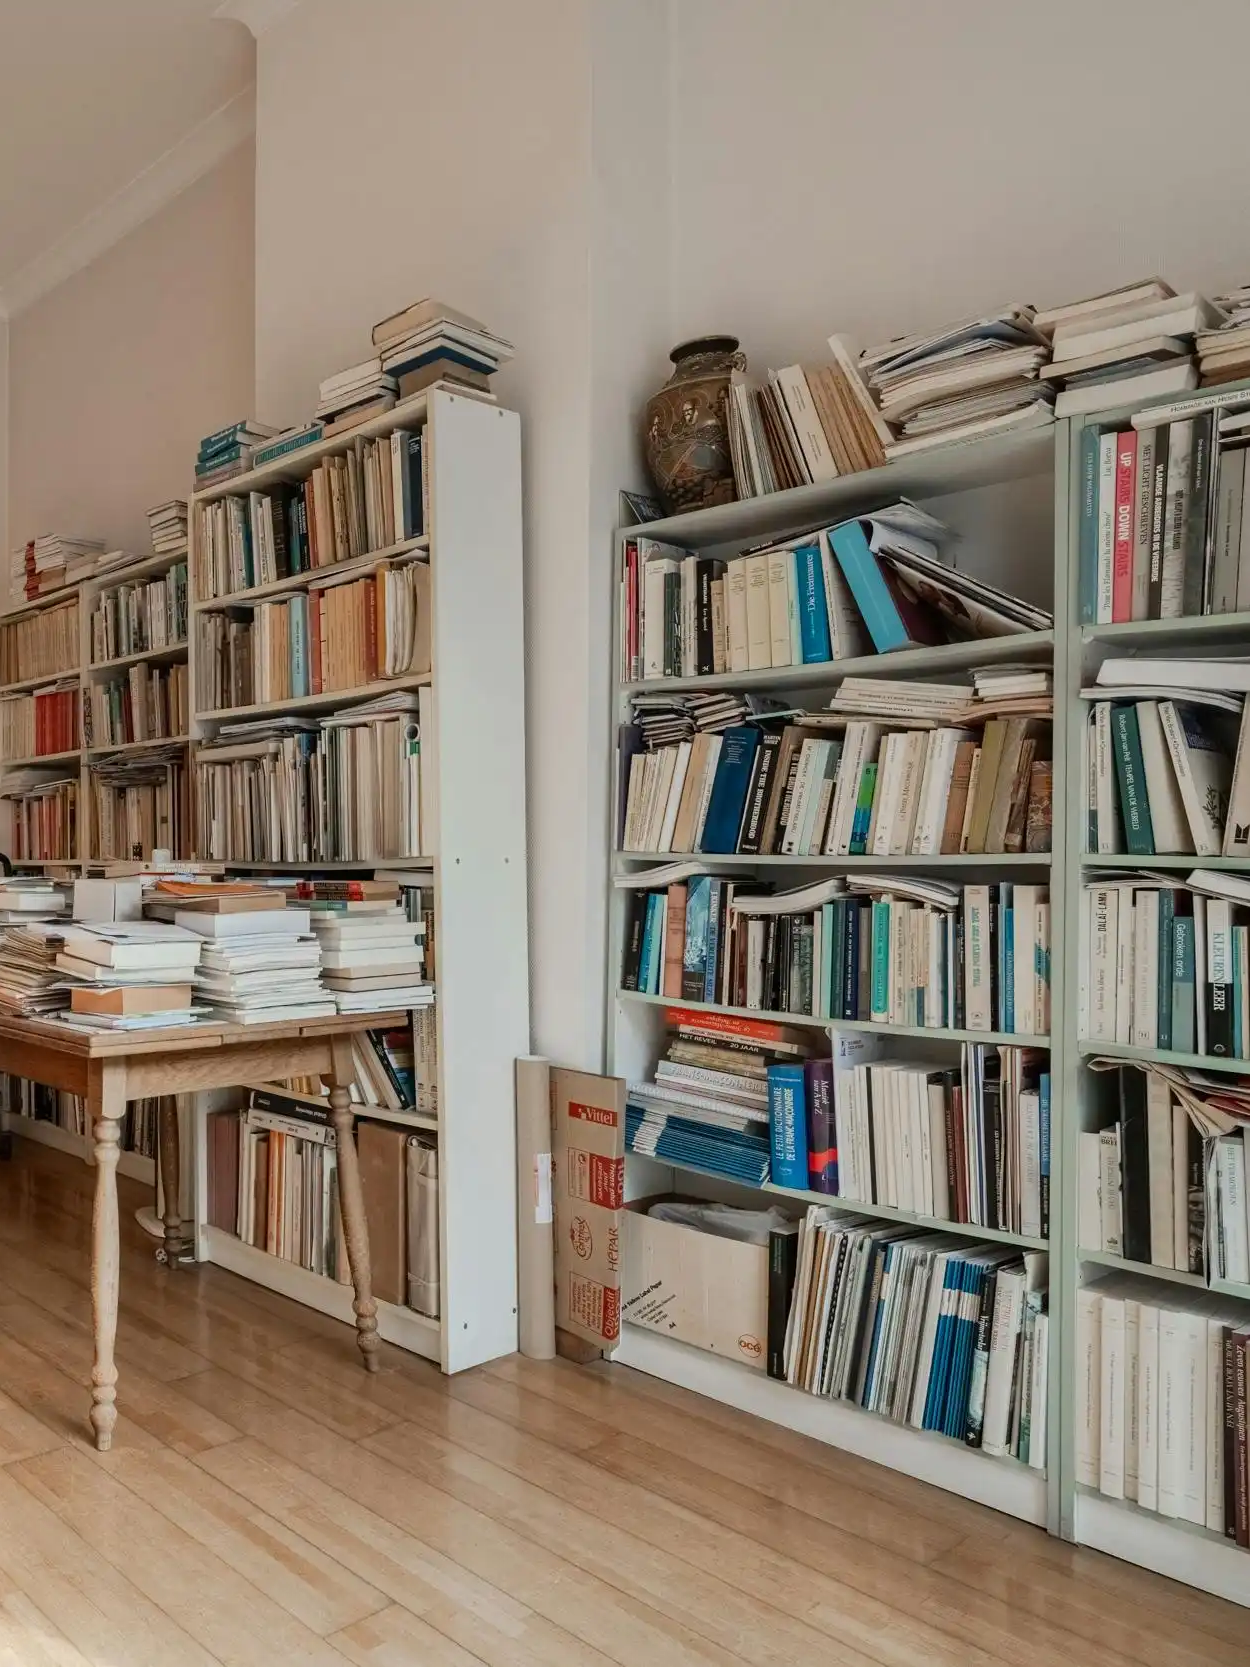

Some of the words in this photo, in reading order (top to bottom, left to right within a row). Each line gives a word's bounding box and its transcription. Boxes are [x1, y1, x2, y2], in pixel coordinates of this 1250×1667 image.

[1120, 451, 1132, 466] UP
[1118, 467, 1131, 503] STAIRS
[1141, 464, 1150, 490] LICHT
[1153, 463, 1164, 495] VLAAMSE
[1116, 504, 1131, 540] DOWN
[1138, 491, 1150, 544] GESCHREVEN
[1151, 497, 1162, 532] ARBEIDERS
[1152, 533, 1159, 541] IN
[1152, 542, 1159, 550] DE
[1116, 541, 1130, 576] STAIRS
[1150, 550, 1160, 582] VREEMDE
[804, 553, 816, 594] Freimaurer
[807, 596, 816, 611] Die
[1118, 714, 1127, 733] Robert
[760, 749, 771, 772] INSIDE
[757, 772, 767, 787] THE
[1124, 764, 1133, 784] TEMPEL
[1128, 797, 1135, 805] DE
[747, 788, 764, 839] BROTHERHOOD
[1130, 806, 1139, 829] WERELD
[1176, 923, 1185, 957] Gebroken
[1176, 960, 1184, 976] orde
[740, 1044, 758, 1052] JAAR
[821, 1080, 830, 1104] Muziek
[587, 1107, 613, 1124] Vittel
[774, 1087, 783, 1133] DICTIONNAIRE
[784, 1088, 795, 1143] FRANC-MAÇONNERIE
[814, 1107, 822, 1115] Z
[775, 1134, 784, 1151] PETIT
[786, 1143, 795, 1152] LA
[776, 1151, 784, 1160] LE
[786, 1152, 795, 1161] DE
[605, 1288, 615, 1337] Objectif
[1236, 1345, 1245, 1366] Zeven
[1237, 1368, 1245, 1395] eeuwen
[1236, 1398, 1246, 1440] Augustijnen
